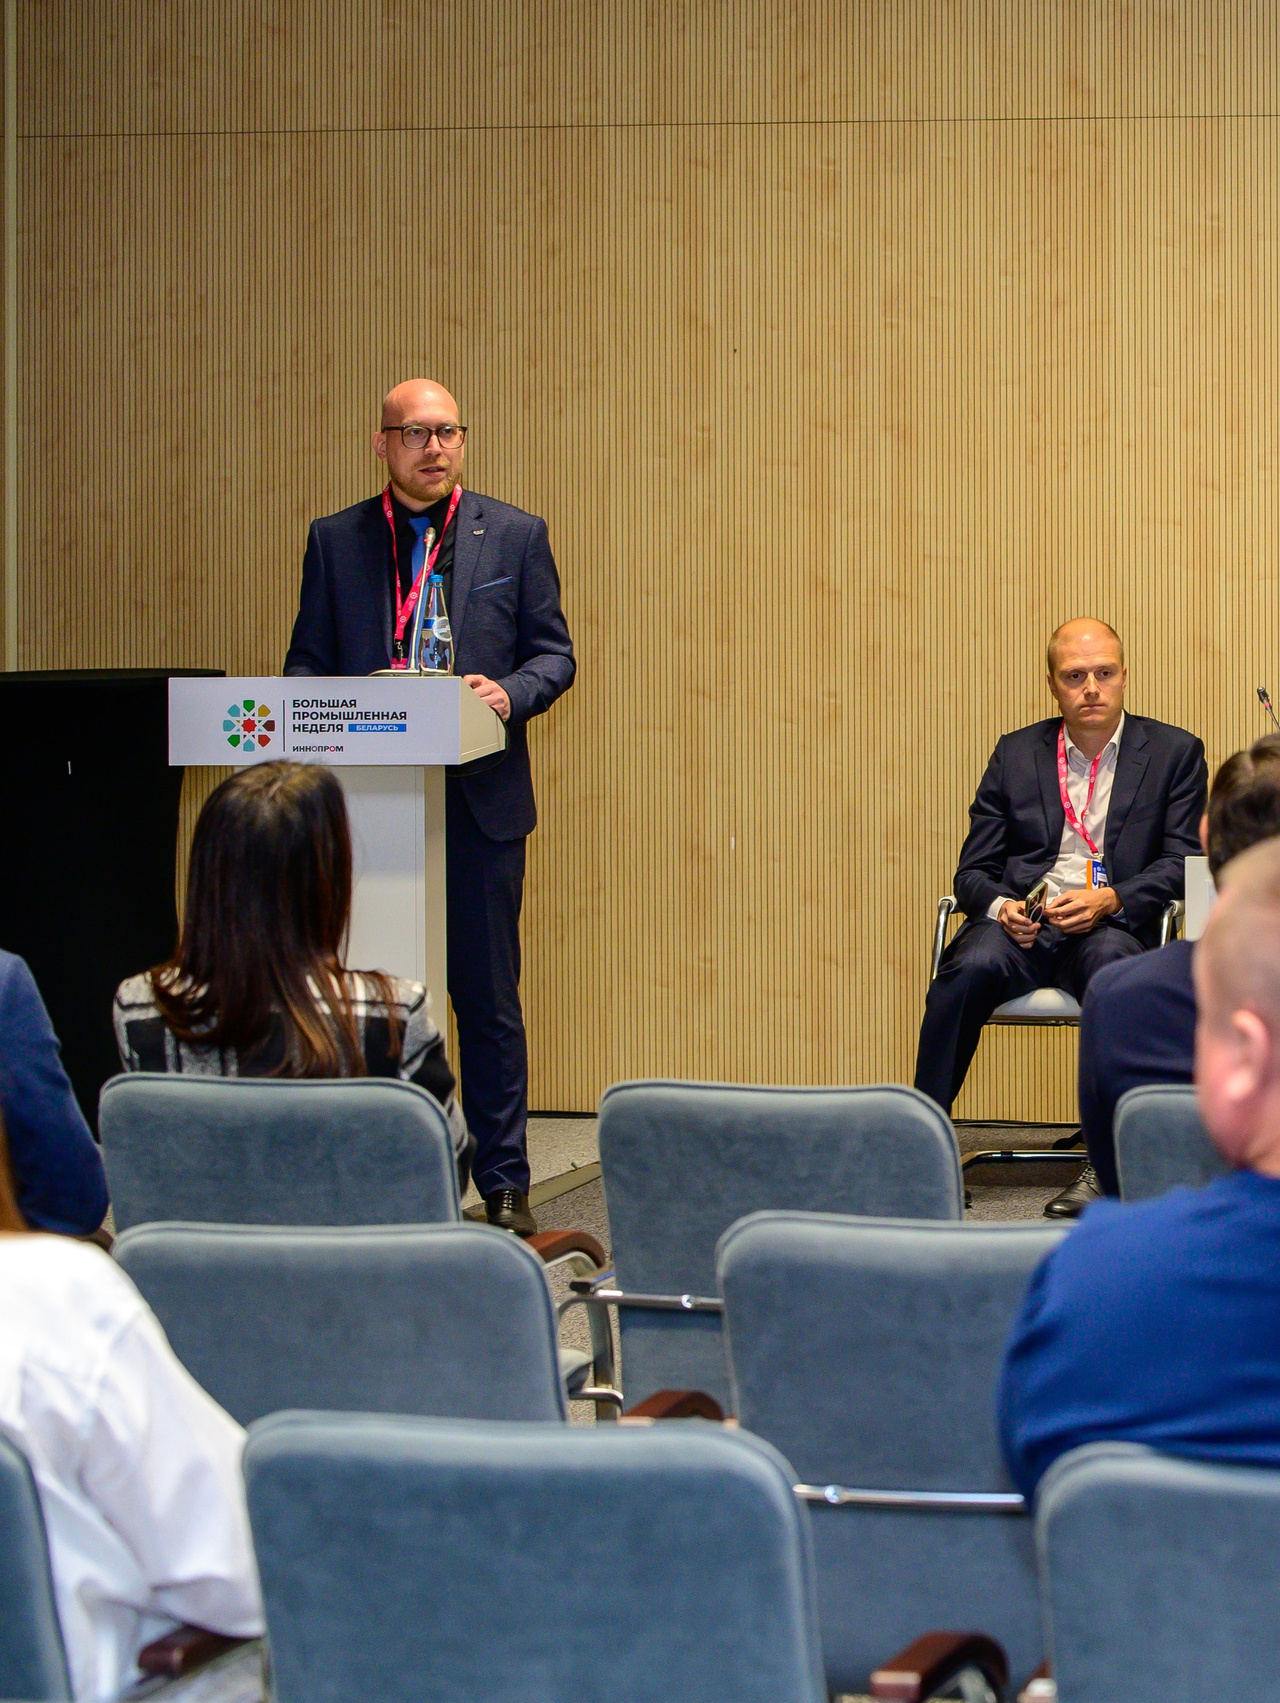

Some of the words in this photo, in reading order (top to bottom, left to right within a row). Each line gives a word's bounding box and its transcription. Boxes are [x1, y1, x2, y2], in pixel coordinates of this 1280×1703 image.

[292, 699, 357, 709] БОЛЬШАЯ
[292, 711, 407, 721] ПРОМЫШЛЕННАЯ
[292, 723, 344, 734] НЕДЕЛЯ
[355, 724, 399, 733] БЕЛАРУСЬ
[292, 745, 344, 753] ИННОПРОМ
